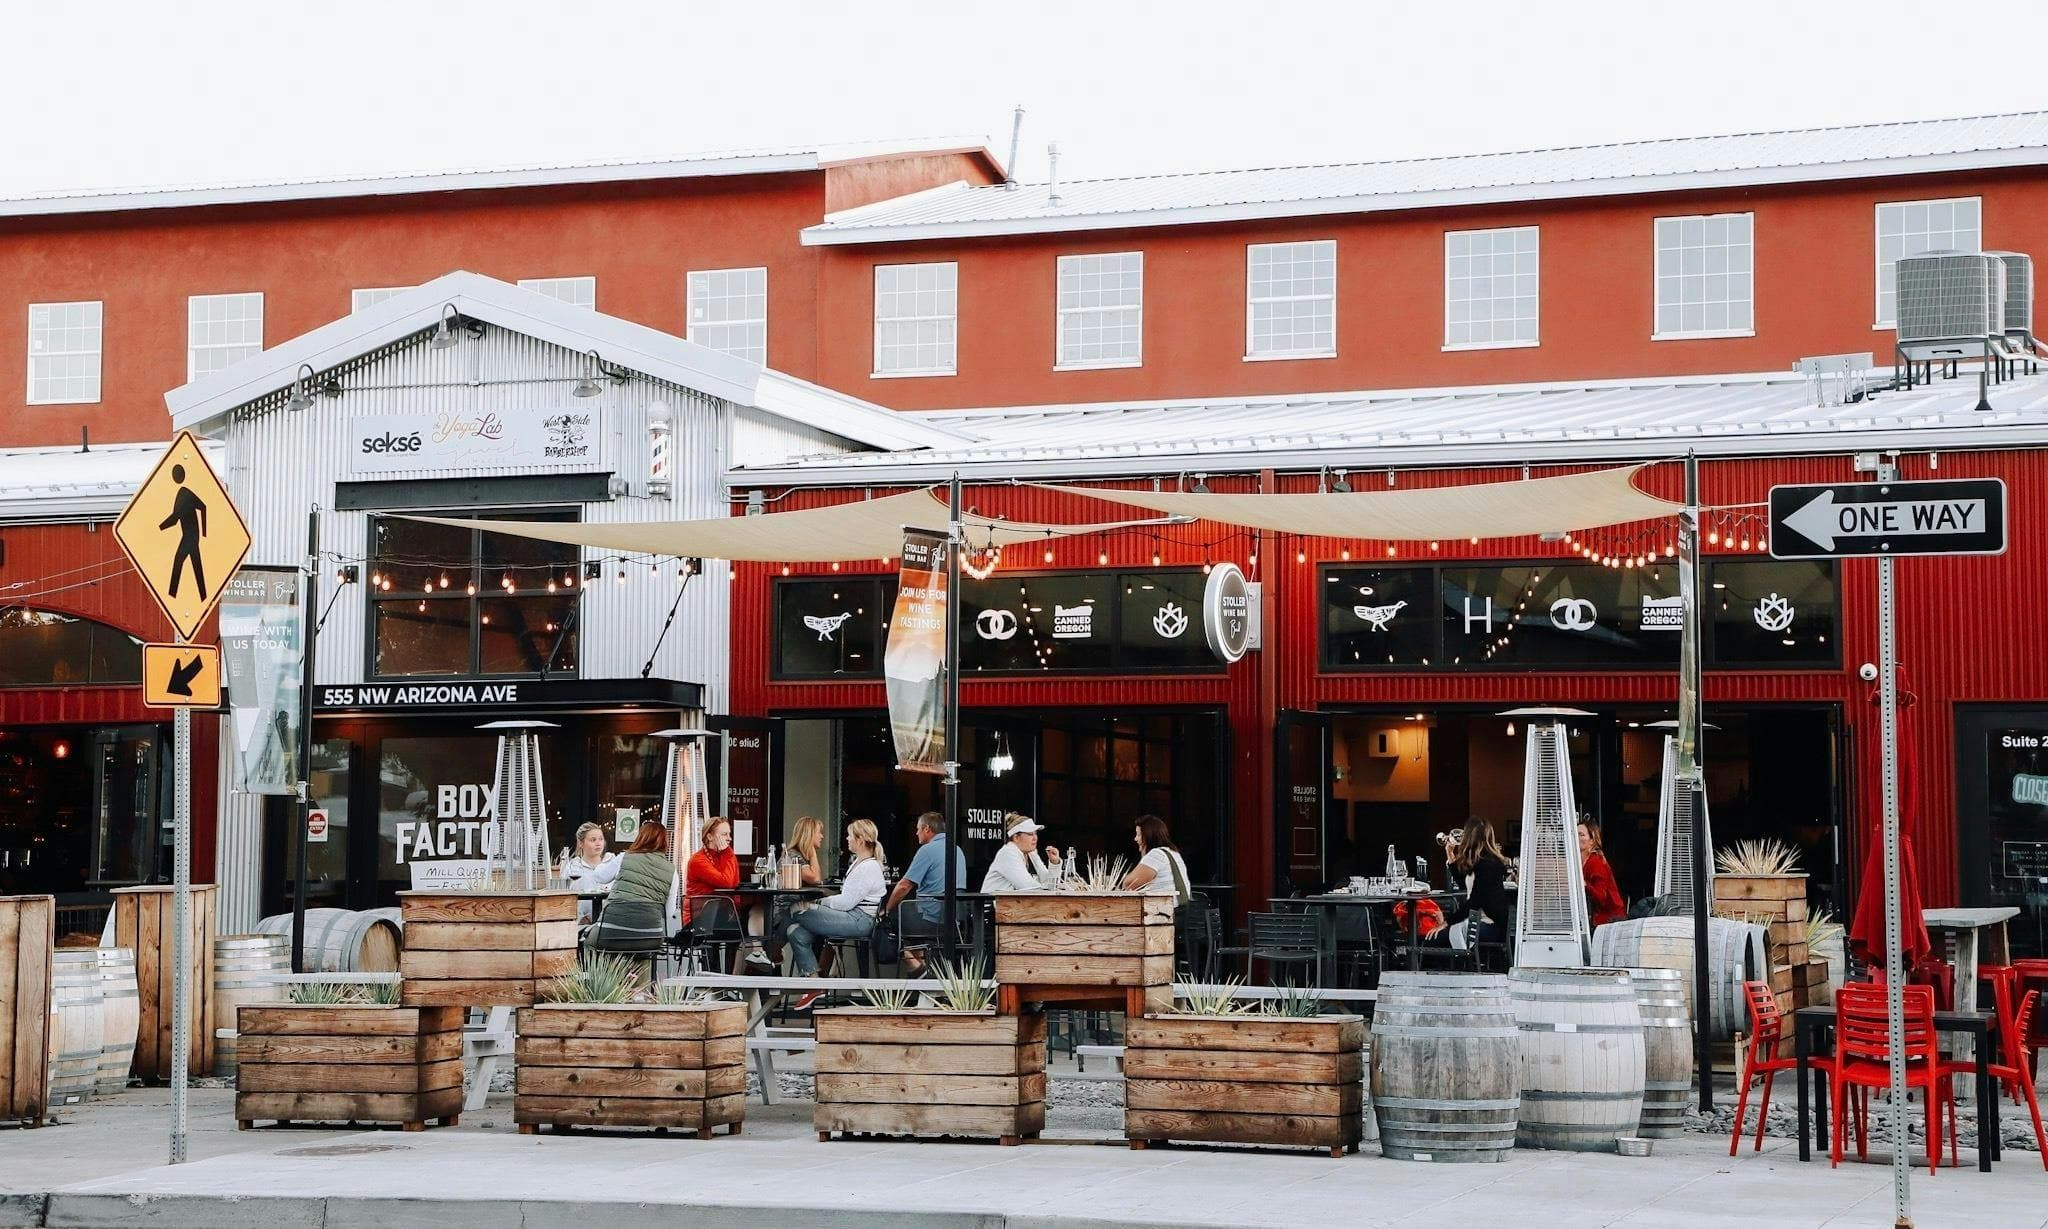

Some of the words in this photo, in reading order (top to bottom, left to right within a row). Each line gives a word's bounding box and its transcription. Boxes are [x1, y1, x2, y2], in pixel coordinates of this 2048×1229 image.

[362, 431, 422, 453] seksé
[544, 445, 589, 458] BARBERSHOP
[1839, 506, 1899, 533] ONE
[1912, 503, 1975, 530] WAY
[904, 543, 928, 555] STOLLER
[228, 580, 265, 588] TOLLER
[222, 589, 245, 597] WINE
[248, 589, 266, 597] BAR
[899, 586, 915, 598] JOIN
[916, 588, 926, 599] US
[928, 589, 946, 601] FOR
[1222, 596, 1246, 607] STOLLER
[908, 602, 932, 615] WINE
[1223, 608, 1236, 617] WINE
[1236, 608, 1246, 617] BAR
[1464, 596, 1492, 634] H
[1642, 607, 1683, 617] CANNED
[899, 616, 942, 630] TASTINGS
[1054, 616, 1092, 625] CANNED
[1642, 616, 1684, 625] OREGON
[264, 625, 292, 637] WITH
[1054, 624, 1092, 633] OREGON
[232, 639, 249, 650] US
[252, 639, 290, 650] TODAY
[323, 688, 354, 706] 555
[358, 687, 391, 705] NW
[394, 686, 478, 704] ARIZONA
[480, 685, 518, 702] AVE
[2001, 735, 2039, 748] Suite
[2015, 776, 2048, 803] CLOSE
[437, 784, 497, 818] BOX
[967, 808, 1002, 824] STOLLER
[967, 827, 986, 840] WINE
[988, 828, 1002, 840] BAR
[426, 867, 453, 877] MILL
[456, 867, 486, 878] QUAR
